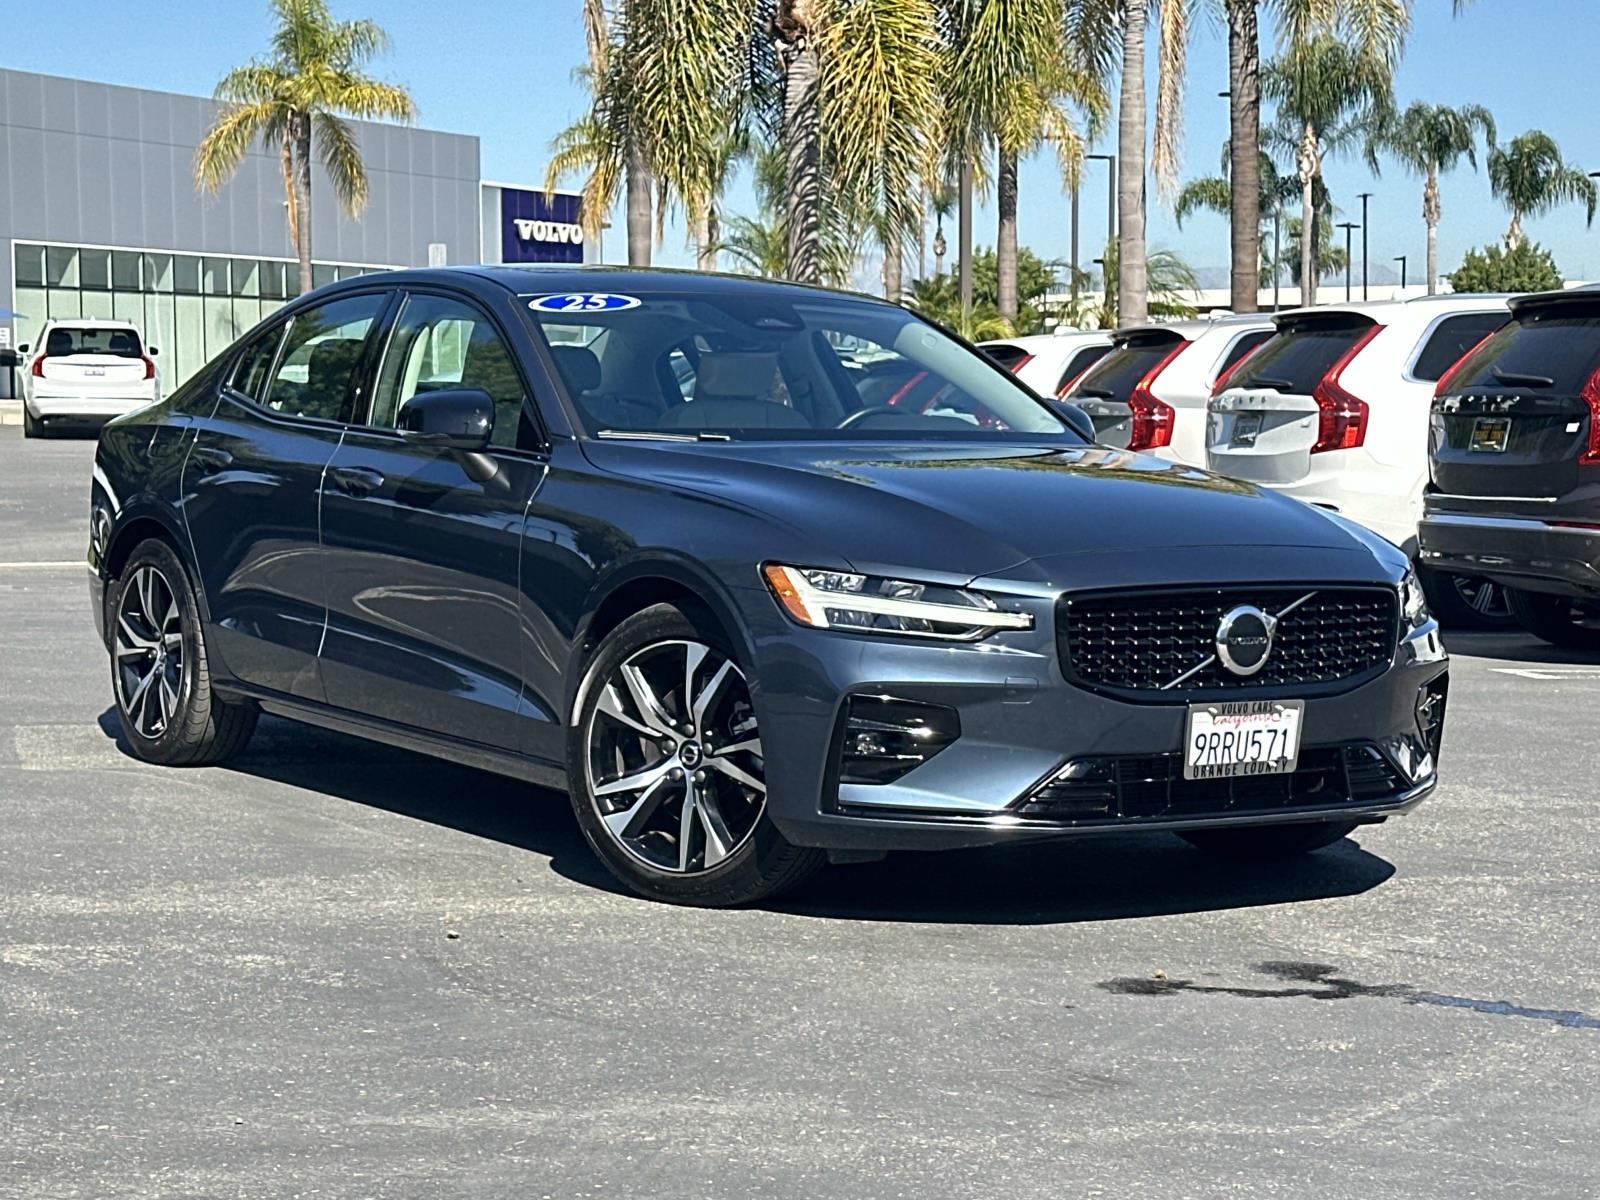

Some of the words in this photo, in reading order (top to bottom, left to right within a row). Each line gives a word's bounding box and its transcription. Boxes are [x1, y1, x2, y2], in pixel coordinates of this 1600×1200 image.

[513, 219, 584, 245] VOLVO
[560, 295, 609, 311] 25
[1221, 703, 1248, 714] VOLVO
[1252, 701, 1273, 713] CARS
[1194, 729, 1288, 766] 9RRU571
[1193, 763, 1237, 778] ORANGE
